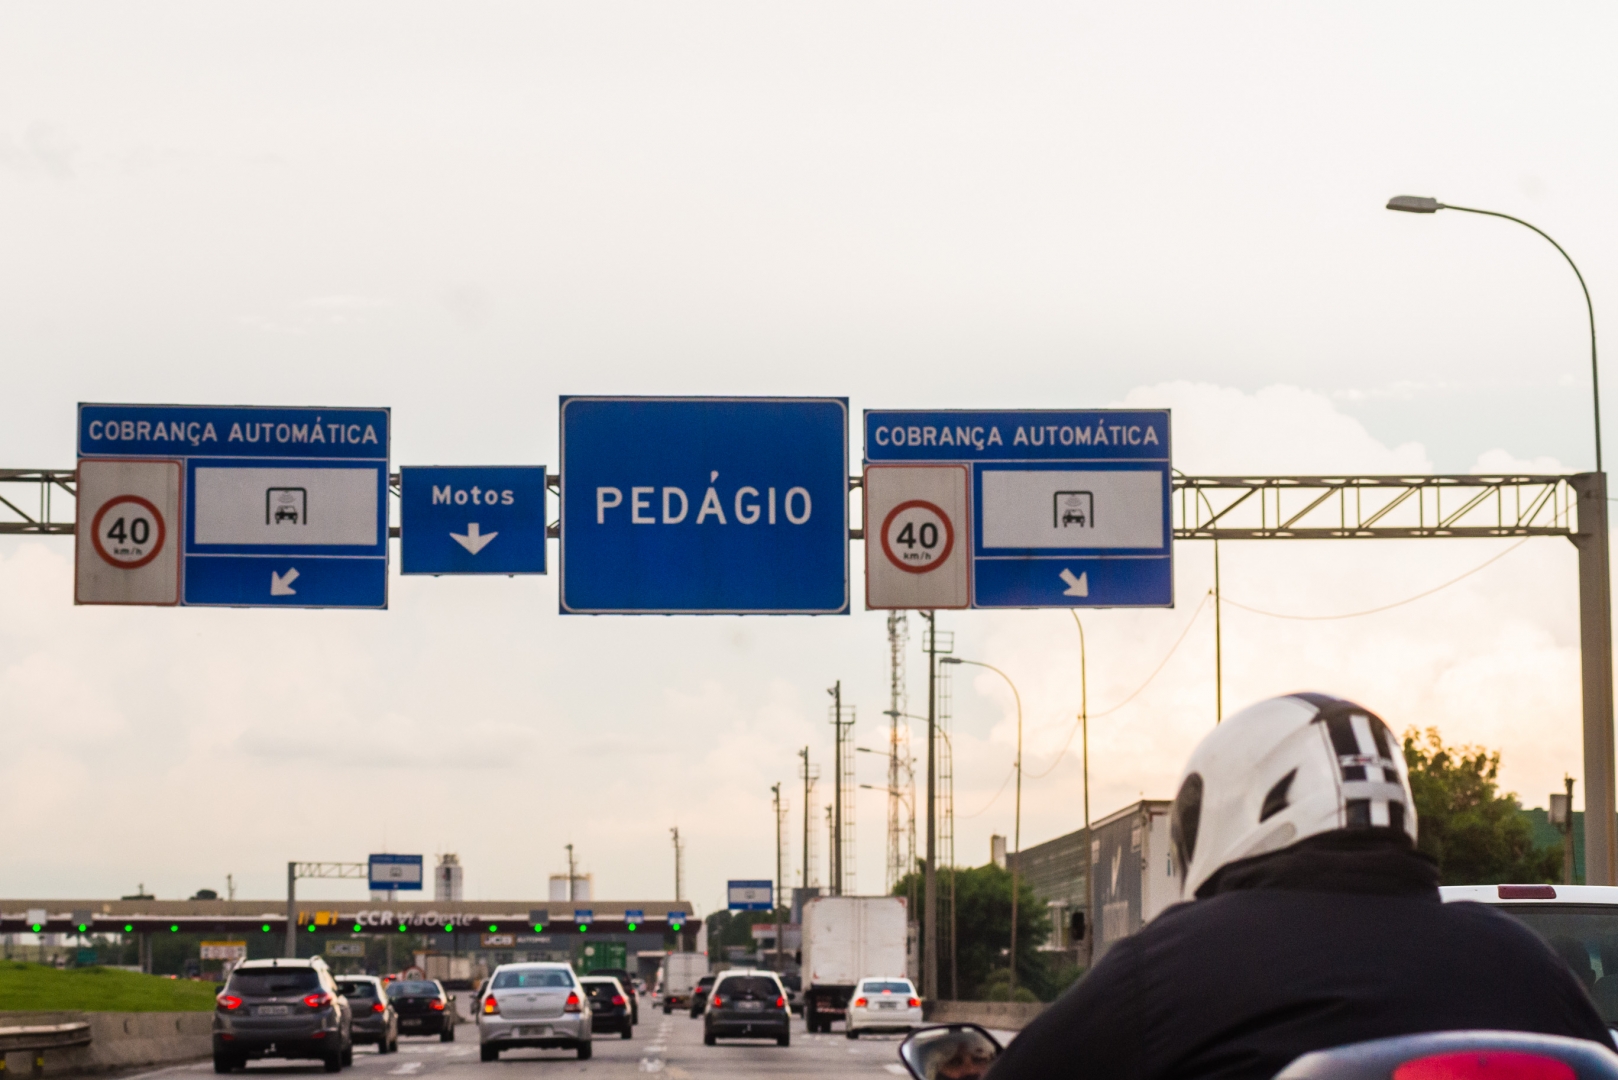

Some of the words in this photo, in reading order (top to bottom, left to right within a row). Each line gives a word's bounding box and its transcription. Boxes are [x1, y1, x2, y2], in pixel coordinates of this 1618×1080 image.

[88, 420, 218, 447] COBRANÇA
[228, 416, 379, 445] AUTOMÁTICA
[874, 425, 1004, 451] COBRANÇA
[1012, 418, 1160, 446] AUTOMÁTICA
[431, 485, 515, 505] Motos
[595, 471, 813, 525] PEDÁGIO
[106, 517, 151, 545] 40
[895, 521, 939, 550] 40
[113, 546, 143, 557] km/h
[903, 551, 932, 562] km/h
[355, 909, 394, 926] CCR
